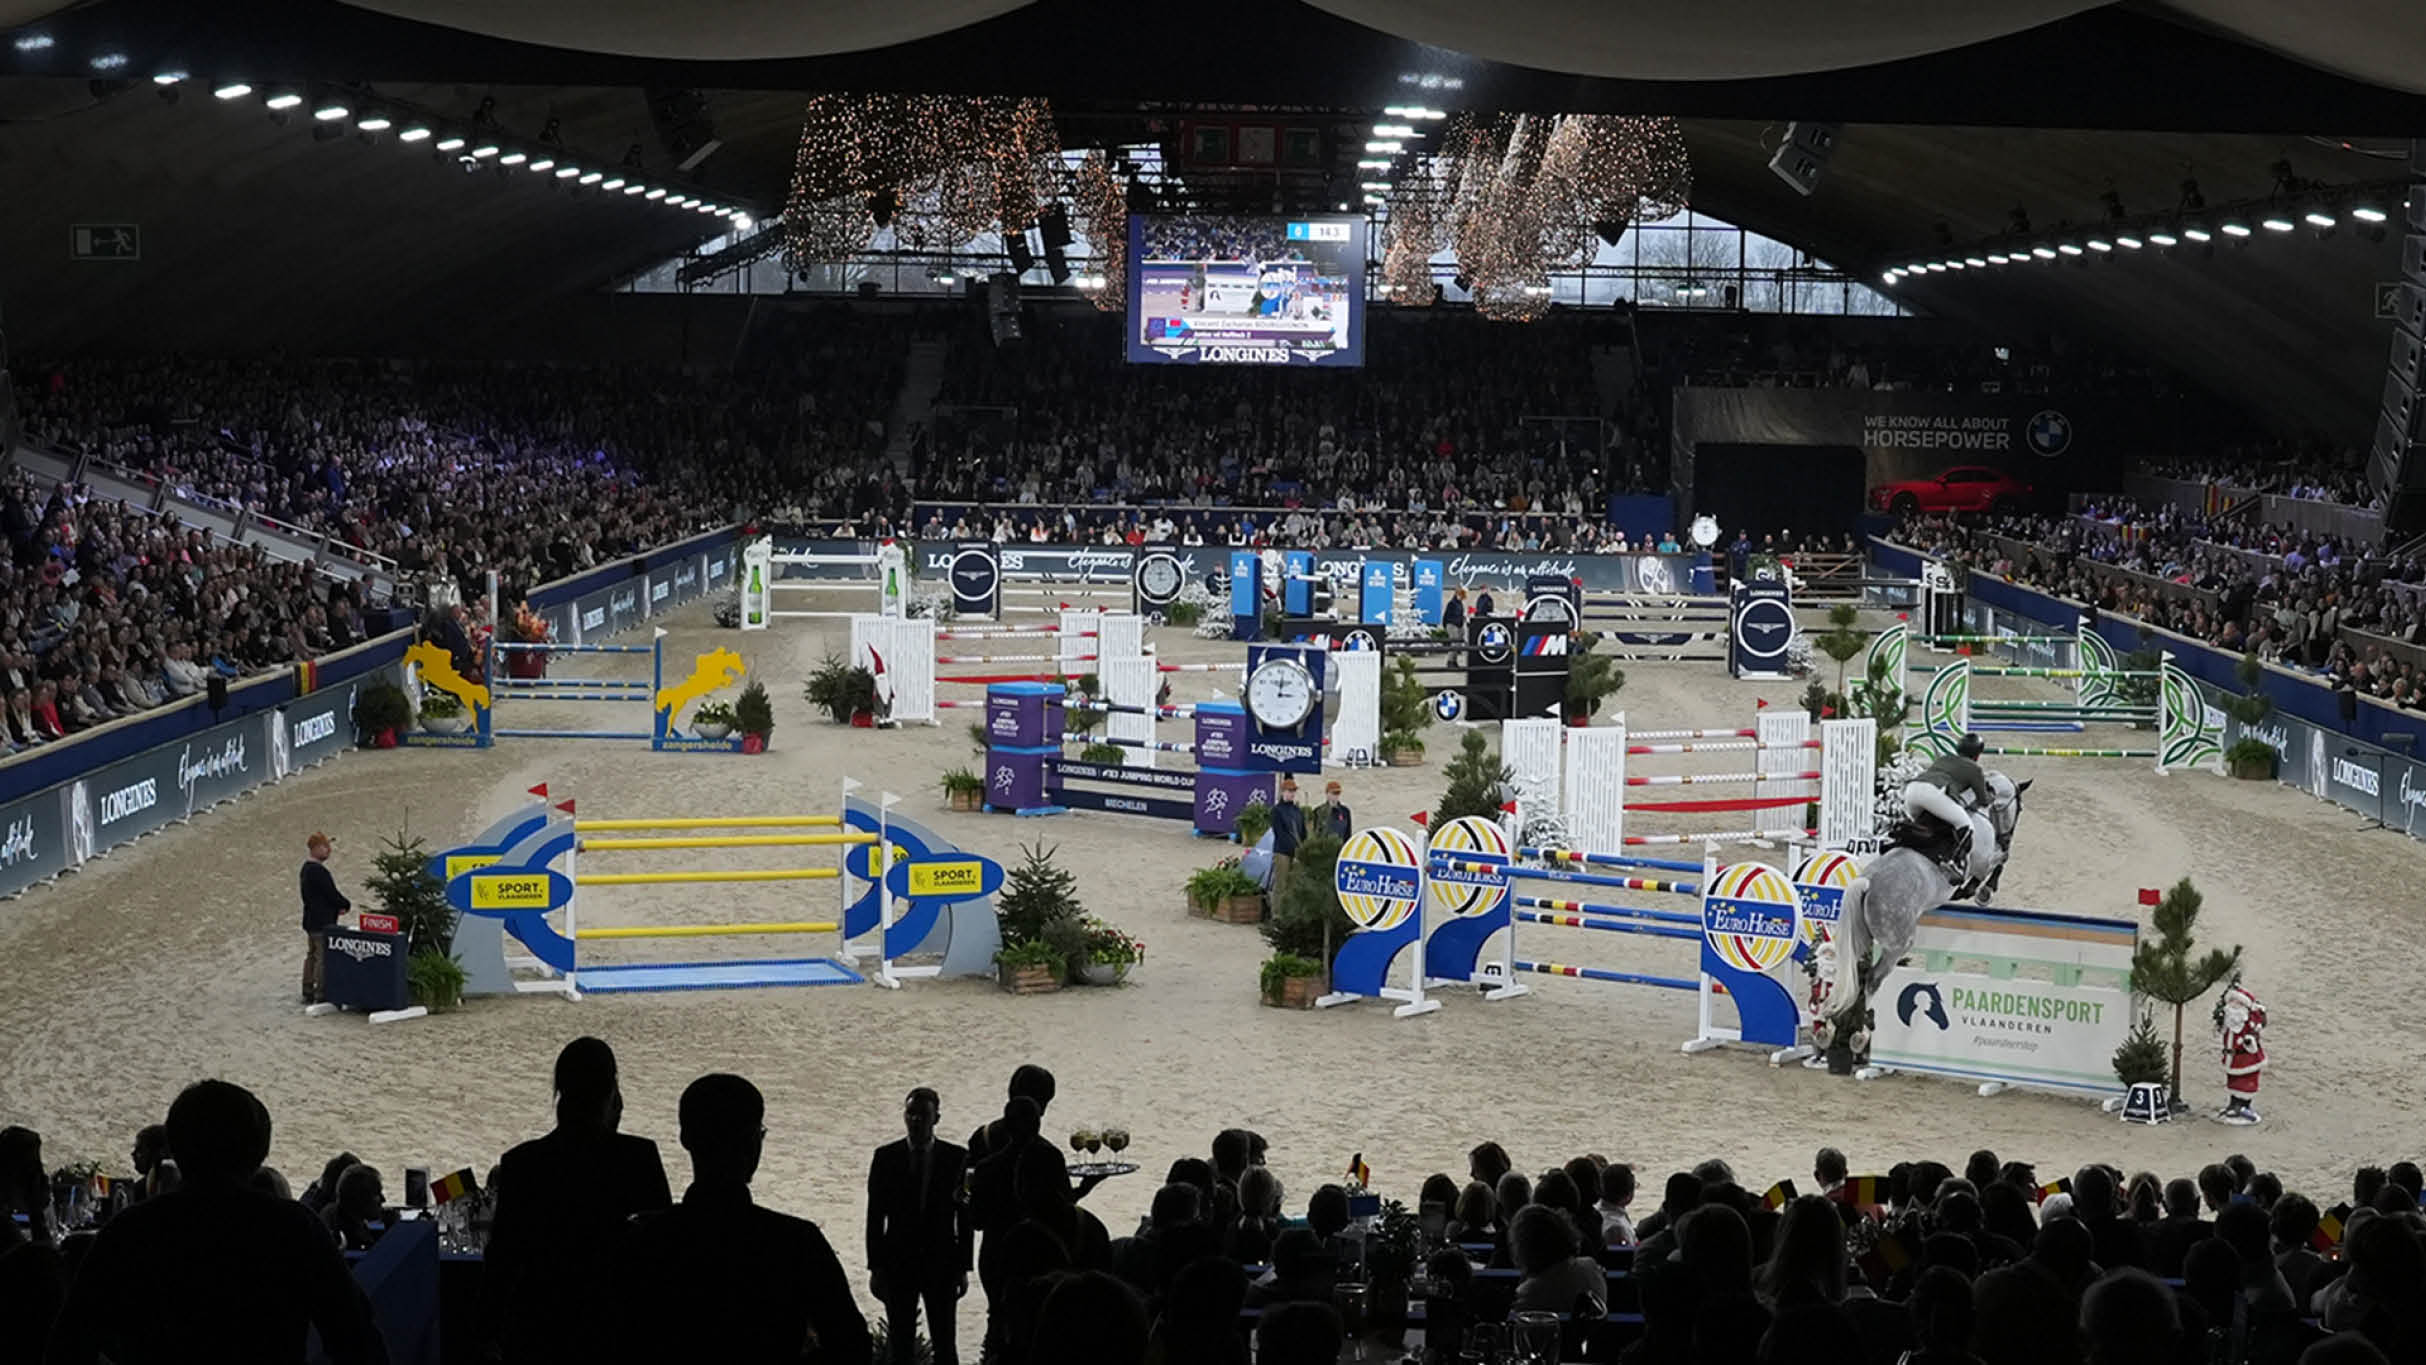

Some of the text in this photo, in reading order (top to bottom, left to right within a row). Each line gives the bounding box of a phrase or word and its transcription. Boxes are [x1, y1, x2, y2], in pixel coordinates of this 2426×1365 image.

[1200, 347, 1290, 363] LONGINES
[1865, 415, 2009, 430] WE KNOW ALL ABOUT
[1864, 429, 2010, 450] HORSEPOWER
[1251, 743, 1313, 758] LONGINES
[1120, 771, 1152, 783] JUMPING
[1154, 774, 1179, 786] WORLD
[2333, 756, 2380, 798] LONGINES
[101, 777, 158, 826] LONGINES
[363, 917, 393, 931] FINISH
[328, 936, 392, 957] LONGINES
[1952, 987, 2105, 1025] PAARDENSPORT
[1962, 1015, 2053, 1034] VLAANDEREN
[2136, 1090, 2145, 1105] 3
